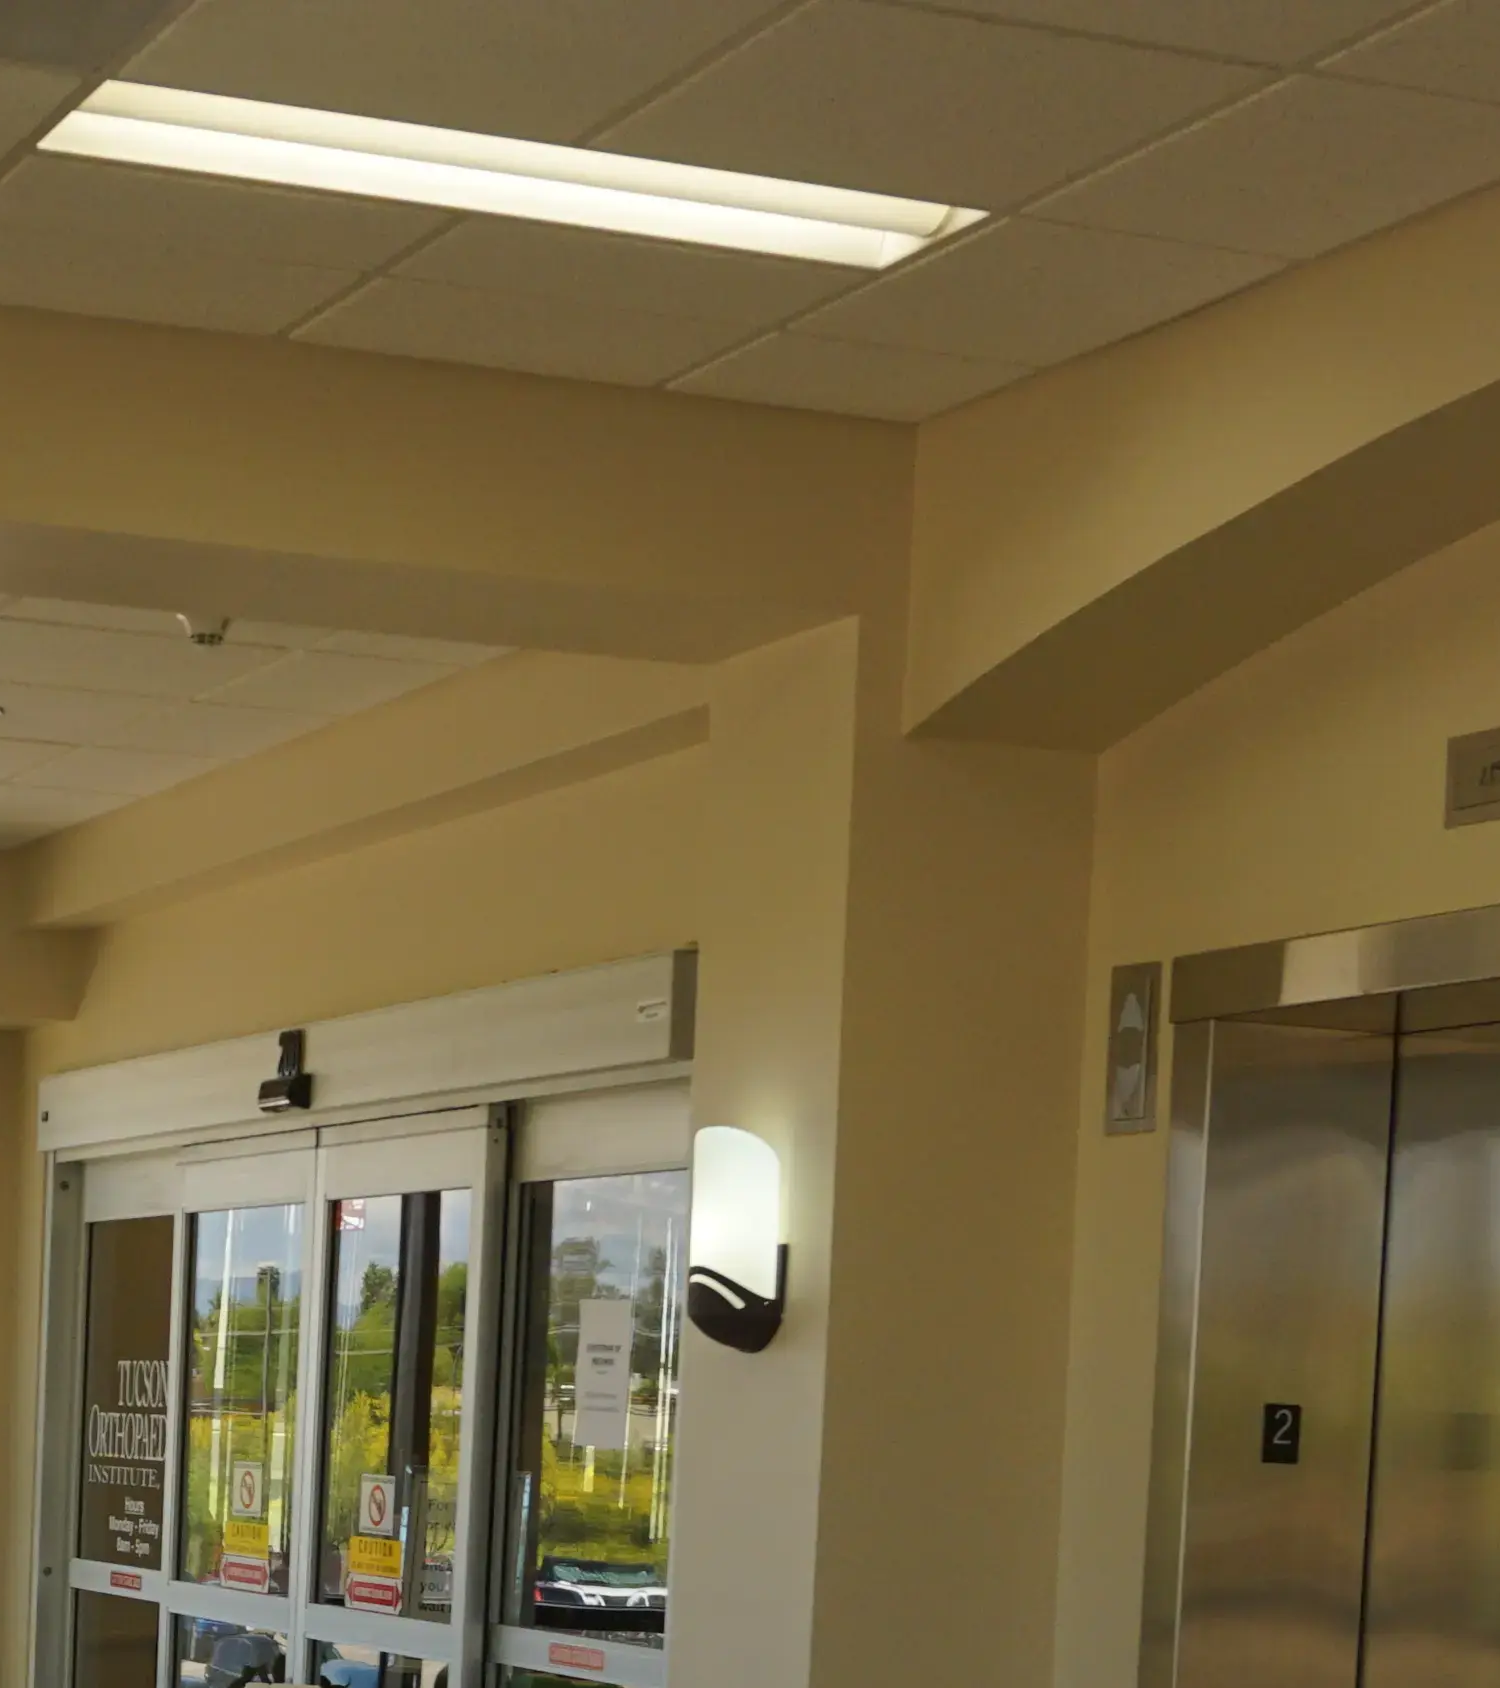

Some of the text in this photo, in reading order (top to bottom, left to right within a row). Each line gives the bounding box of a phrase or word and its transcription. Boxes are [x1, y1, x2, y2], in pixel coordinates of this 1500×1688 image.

[88, 1403, 167, 1462] ORTHOPAED
[1272, 1409, 1293, 1444] 2
[109, 1515, 133, 1536] Monday
[138, 1518, 160, 1540] Friday
